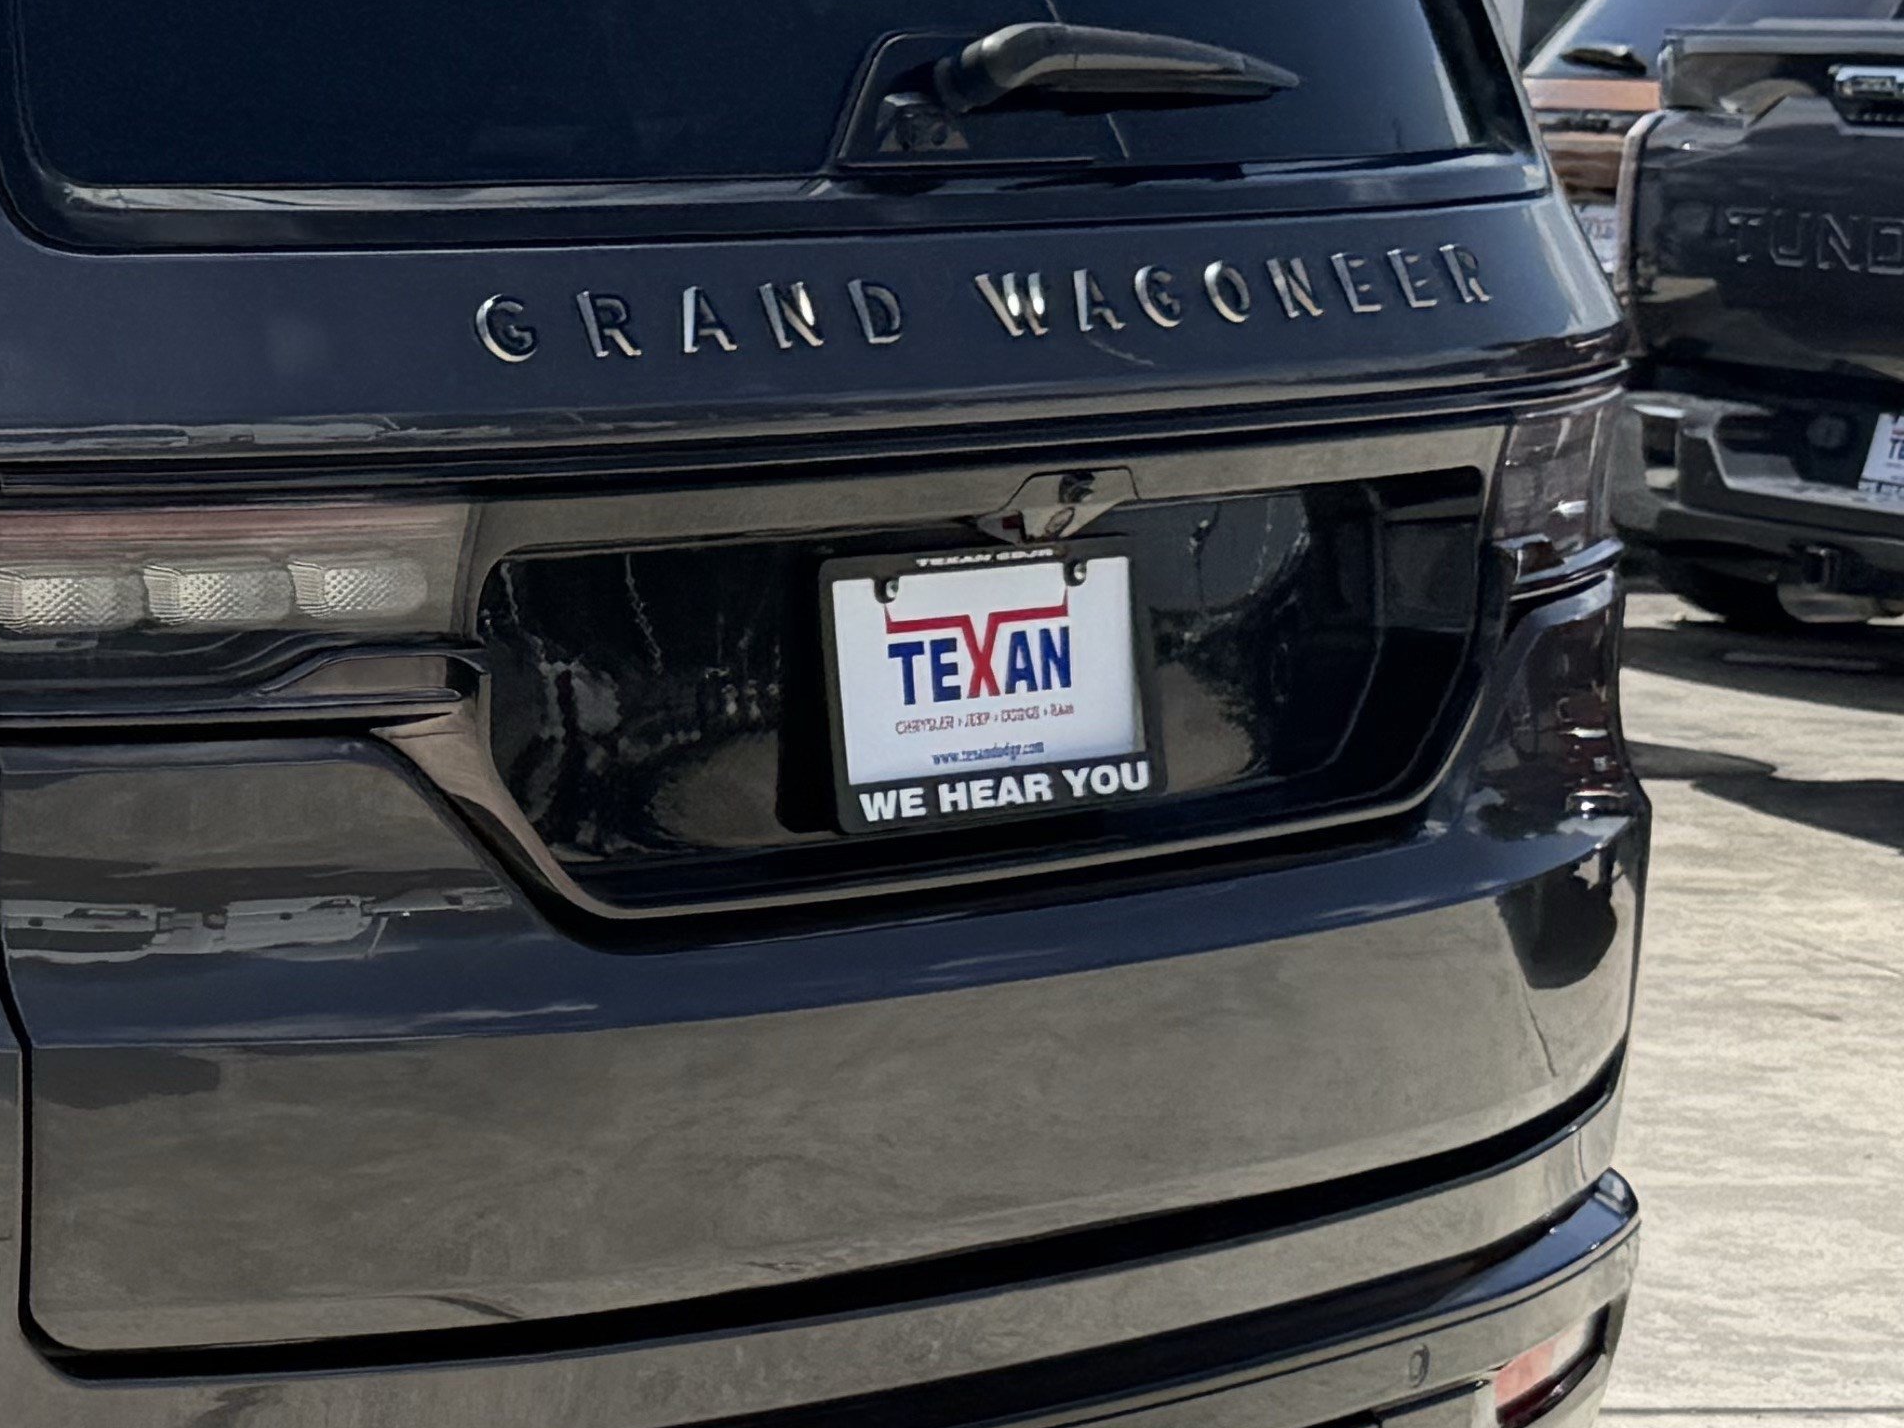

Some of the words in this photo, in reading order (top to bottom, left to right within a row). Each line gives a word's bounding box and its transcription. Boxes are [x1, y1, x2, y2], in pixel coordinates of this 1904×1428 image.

[475, 278, 904, 363] GRAND
[974, 243, 1492, 337] WAGONEER
[916, 553, 992, 567] TEXAN
[887, 615, 1071, 705] TEXAN
[858, 786, 927, 822] WE
[938, 772, 1054, 814] HEAR
[1061, 759, 1151, 798] YOU
